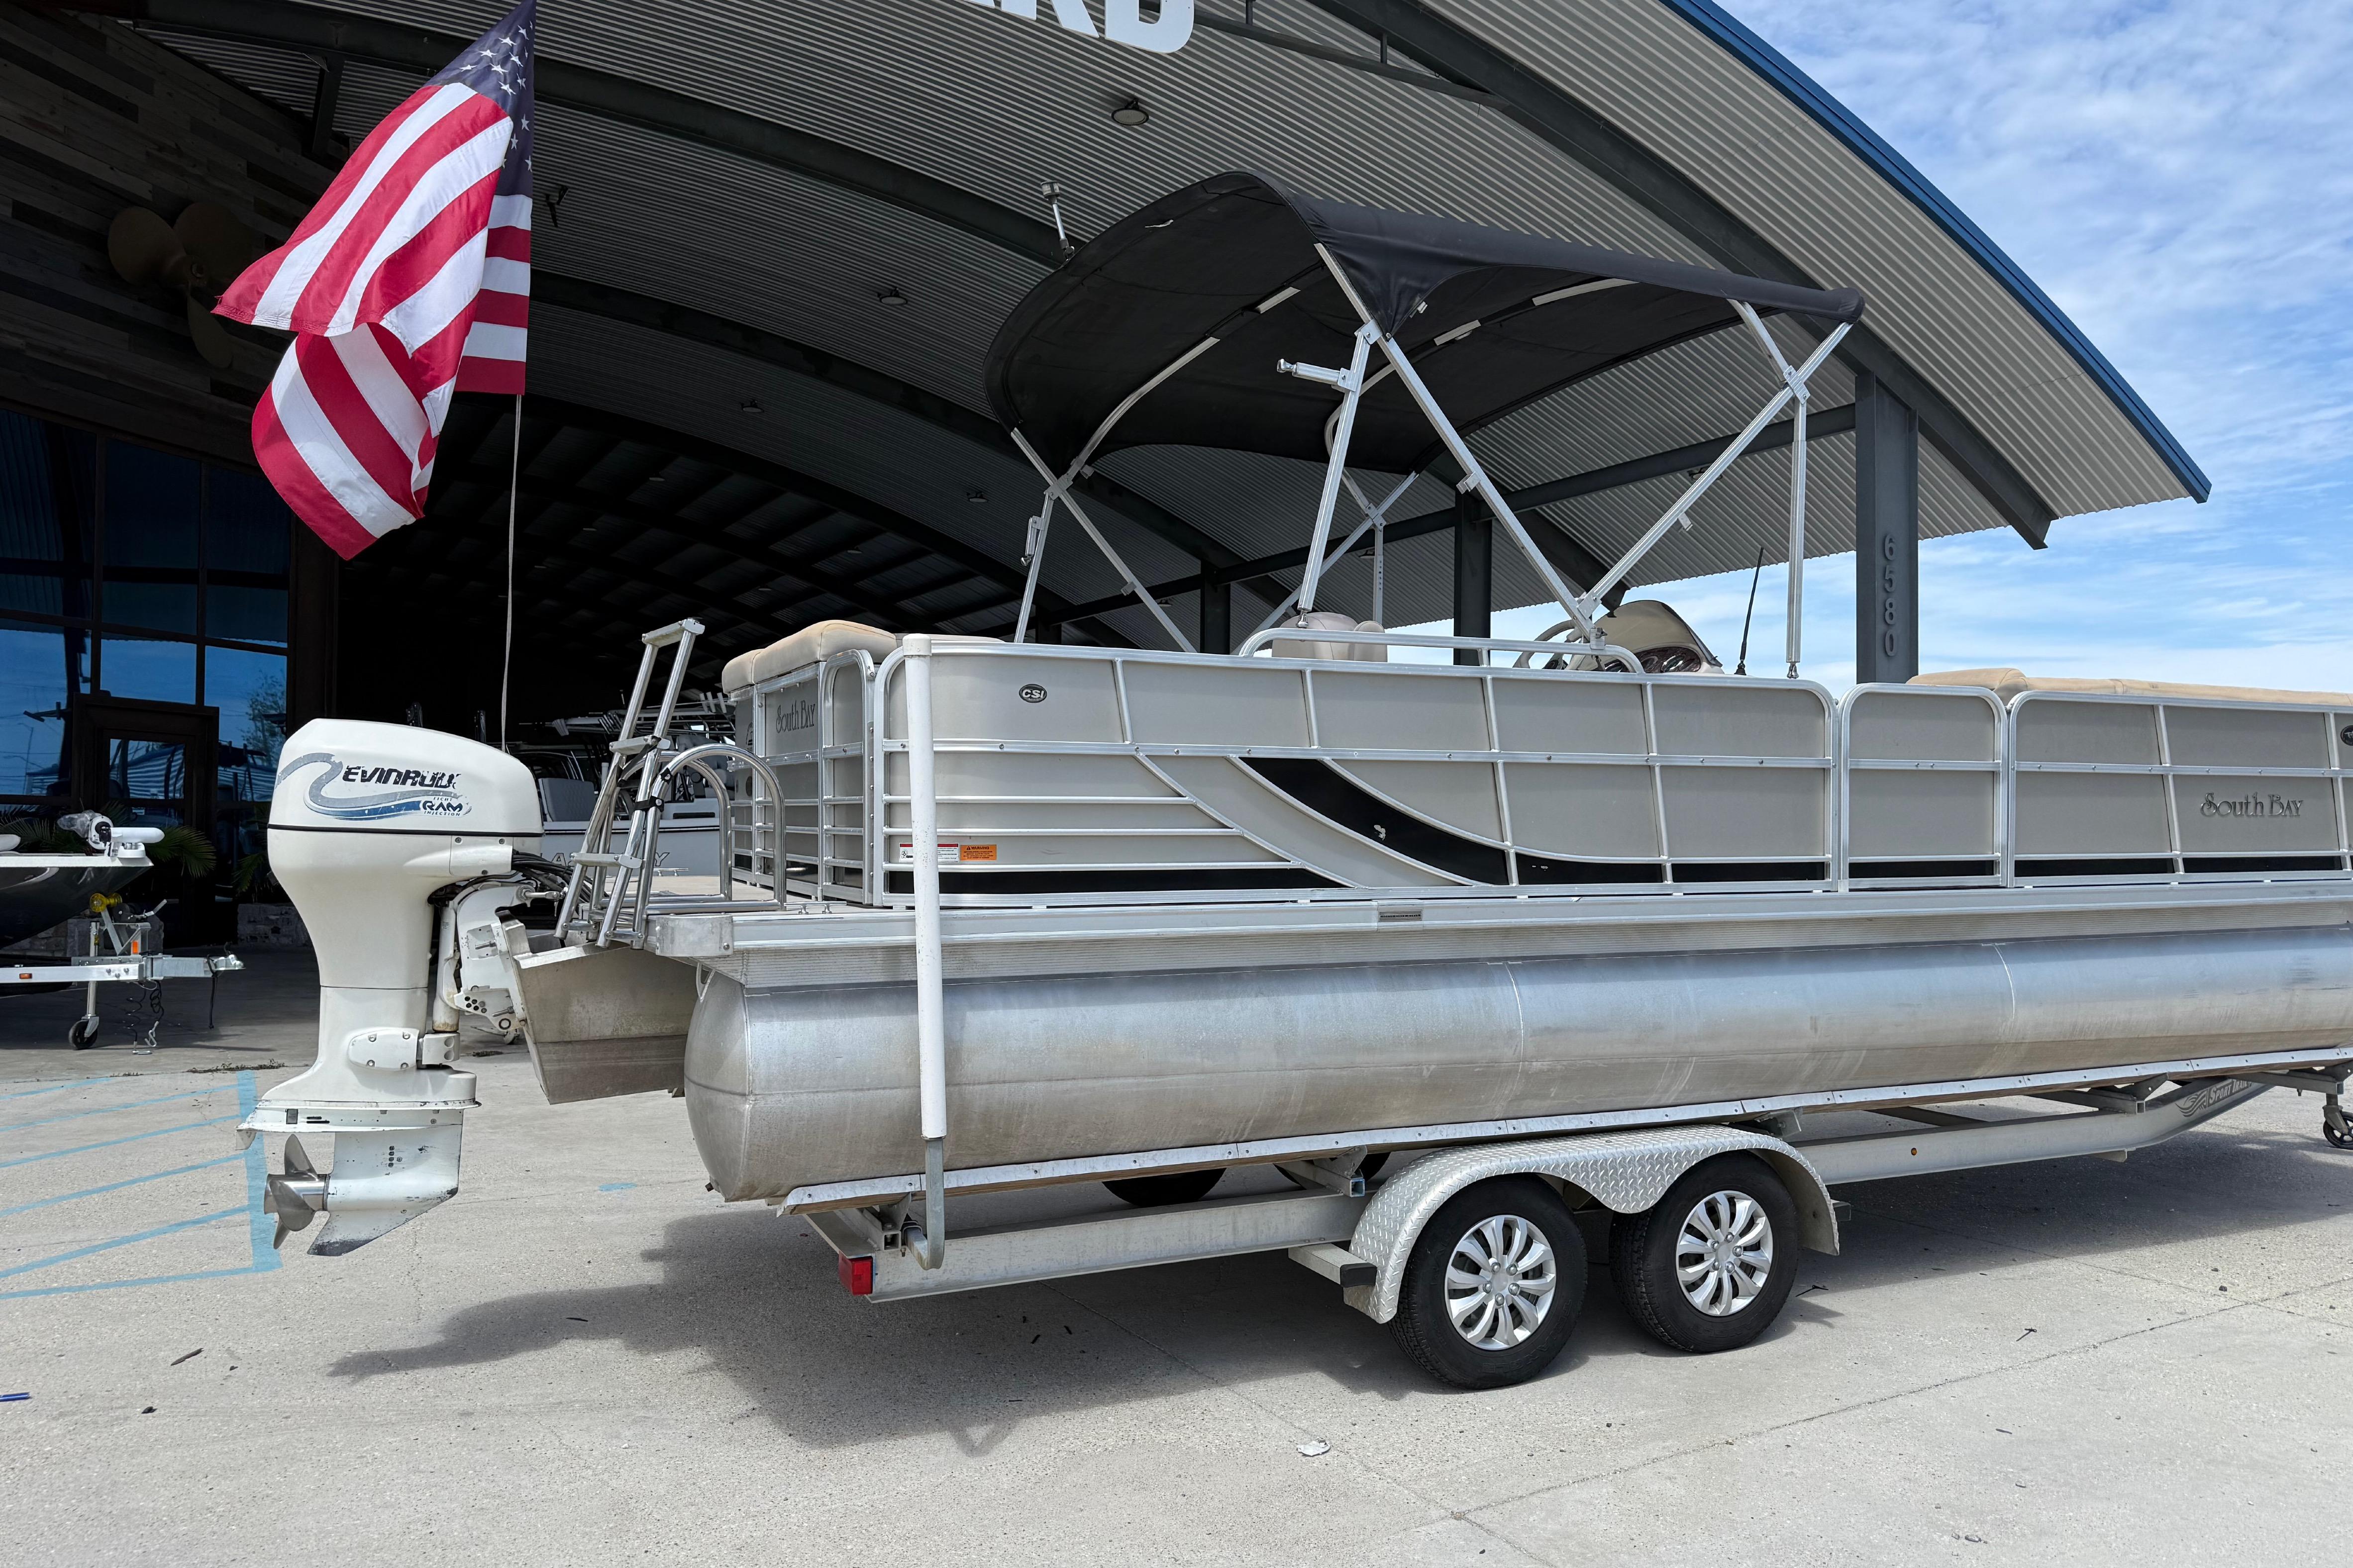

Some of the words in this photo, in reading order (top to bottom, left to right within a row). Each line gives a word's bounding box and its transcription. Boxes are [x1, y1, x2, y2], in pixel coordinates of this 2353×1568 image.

[1884, 533, 1896, 657] 6580
[1023, 689, 1044, 698] CSI
[776, 700, 799, 733] South
[342, 765, 461, 789] EVINRUD
[422, 800, 463, 812] RAM
[2200, 792, 2264, 817] South
